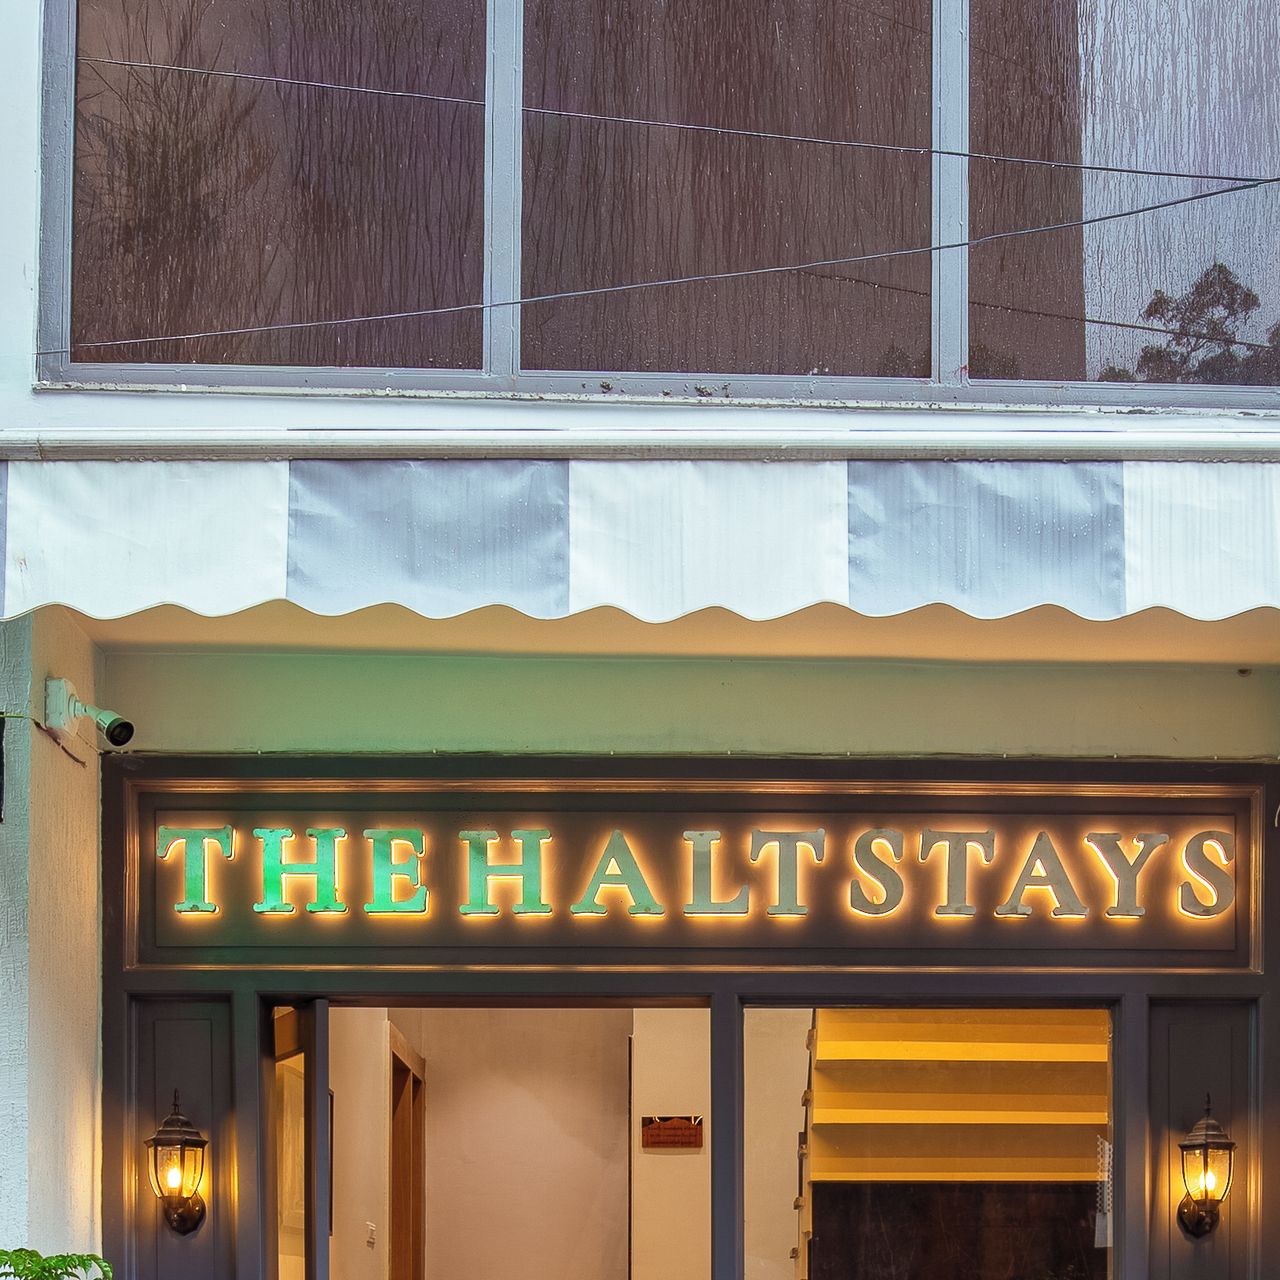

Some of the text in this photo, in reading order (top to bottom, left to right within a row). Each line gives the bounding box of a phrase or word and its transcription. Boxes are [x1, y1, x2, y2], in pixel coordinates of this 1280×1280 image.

[157, 824, 1236, 918] THE HALT STAYS
